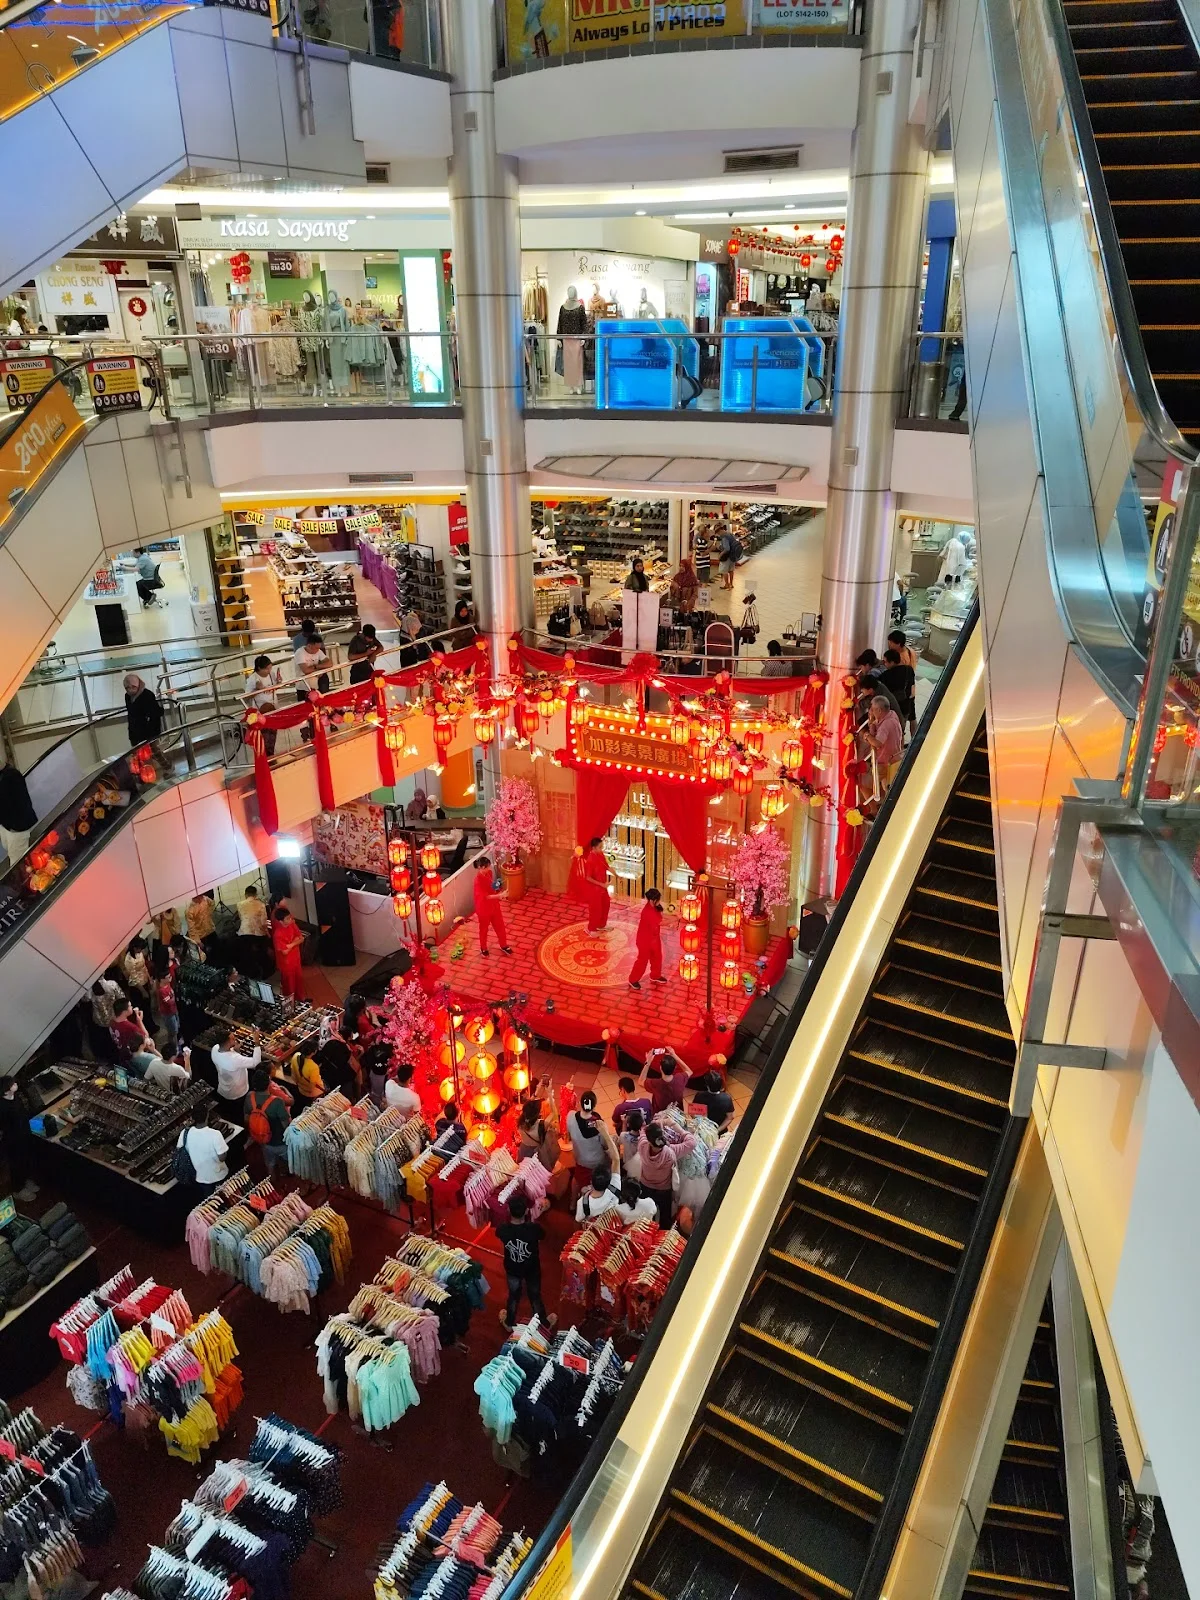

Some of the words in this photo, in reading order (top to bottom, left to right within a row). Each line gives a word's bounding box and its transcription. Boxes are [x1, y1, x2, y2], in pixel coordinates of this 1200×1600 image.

[776, 10, 793, 18] (LOT
[573, 25, 629, 43] Always
[632, 20, 666, 35] Low
[669, 14, 725, 31] Prices
[220, 219, 270, 237] Rasa
[277, 218, 349, 241] Sayang
[578, 256, 608, 275] Rasa
[47, 275, 78, 287] CHONG
[80, 276, 104, 287] SENG
[10, 360, 43, 370] WARNING
[96, 361, 128, 370] WARNING
[248, 511, 264, 525] SALE
[363, 513, 380, 526] SALE
[274, 519, 291, 531] SALE
[301, 522, 318, 533] SALE
[320, 522, 337, 533] SALE
[345, 519, 362, 530] SALE
[569, 1359, 580, 1367] 20
